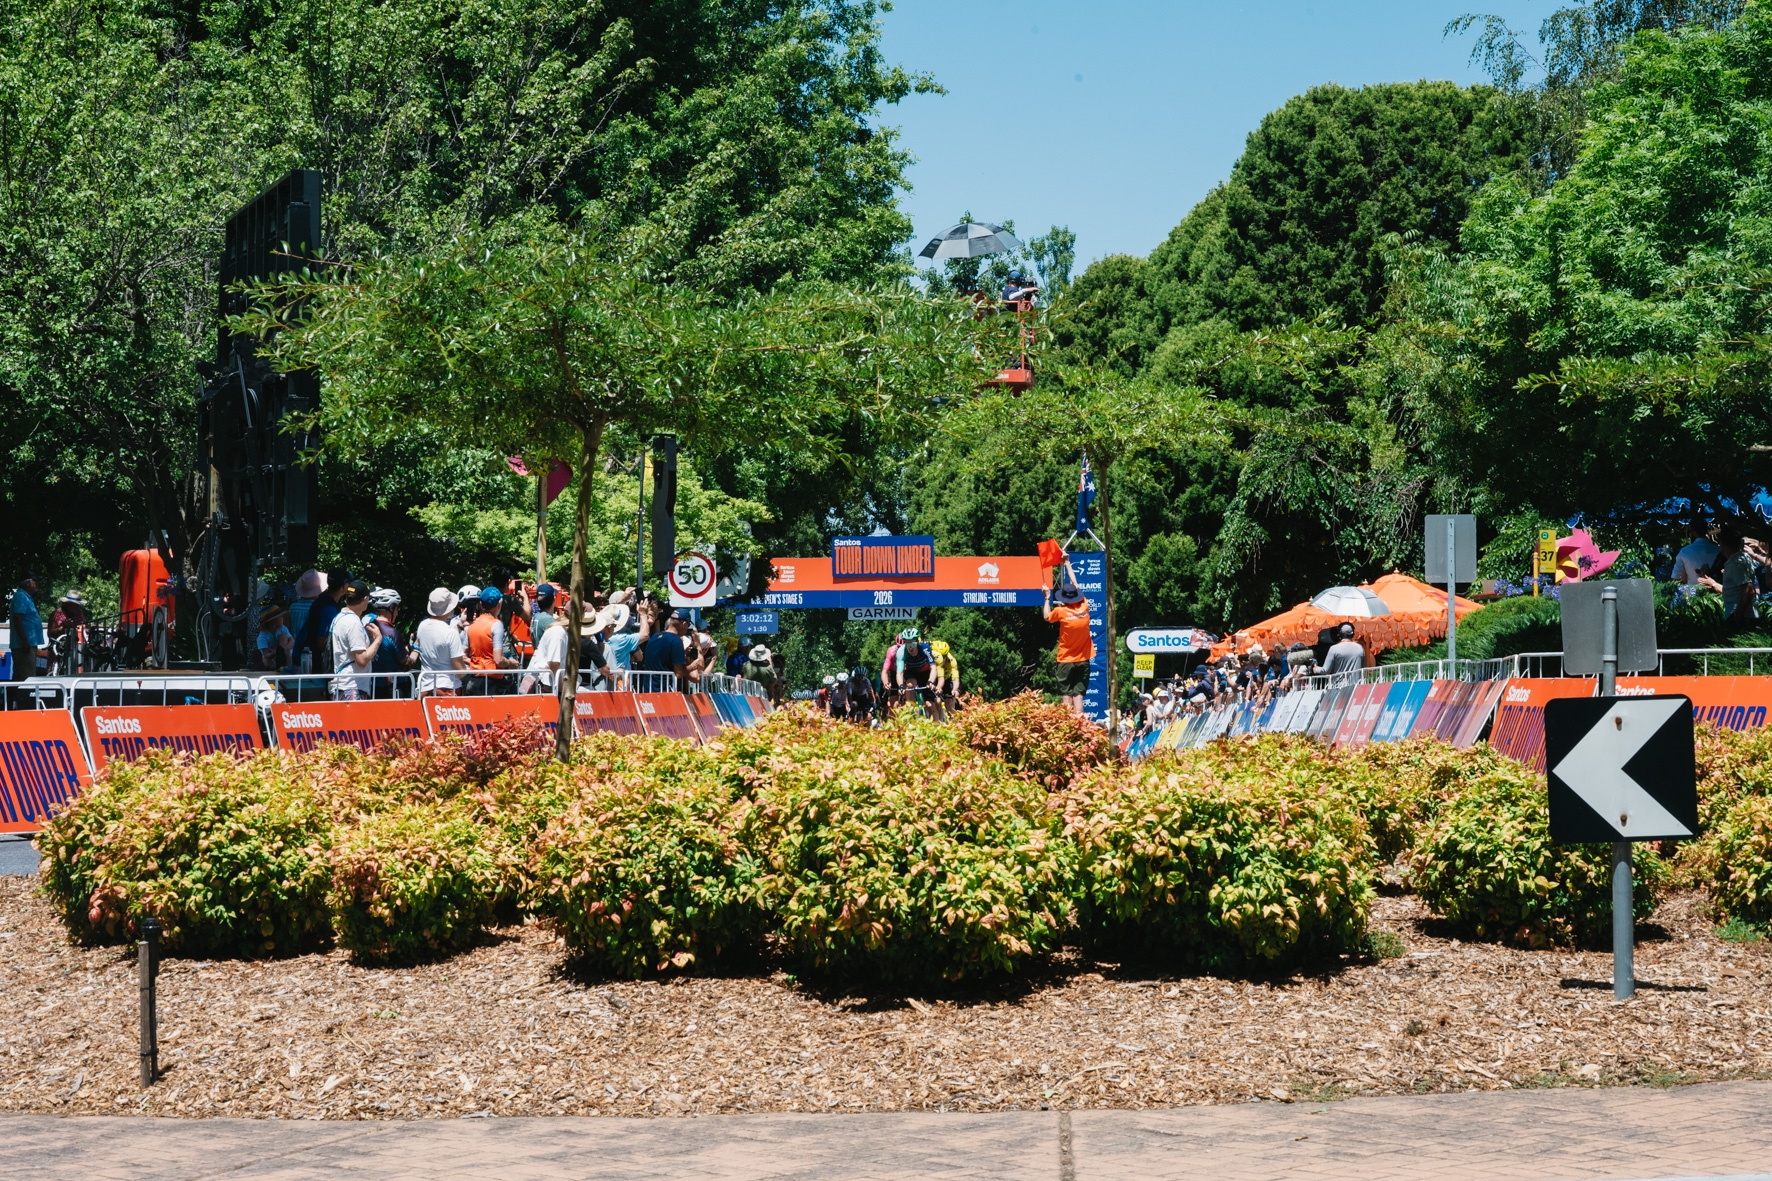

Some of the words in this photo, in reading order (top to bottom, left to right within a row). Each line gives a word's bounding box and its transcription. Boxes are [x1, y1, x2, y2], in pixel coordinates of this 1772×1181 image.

[834, 546, 862, 574] TOUR
[863, 546, 896, 574] DOWN
[897, 545, 932, 574] UNDER
[1540, 551, 1554, 561] 37
[678, 564, 707, 585] 50
[782, 593, 798, 605] STAGE
[798, 593, 803, 605] 5
[874, 590, 893, 605] 2026
[963, 592, 988, 604] STIRLING
[992, 592, 1017, 604] STIRLING
[741, 614, 773, 623] 3:02:12
[852, 608, 913, 618] GARMIN
[1138, 634, 1191, 647] Santos
[282, 711, 323, 729] Santos
[435, 705, 472, 721] Santos
[95, 715, 141, 735] Santos
[5, 740, 82, 822] UNDER
